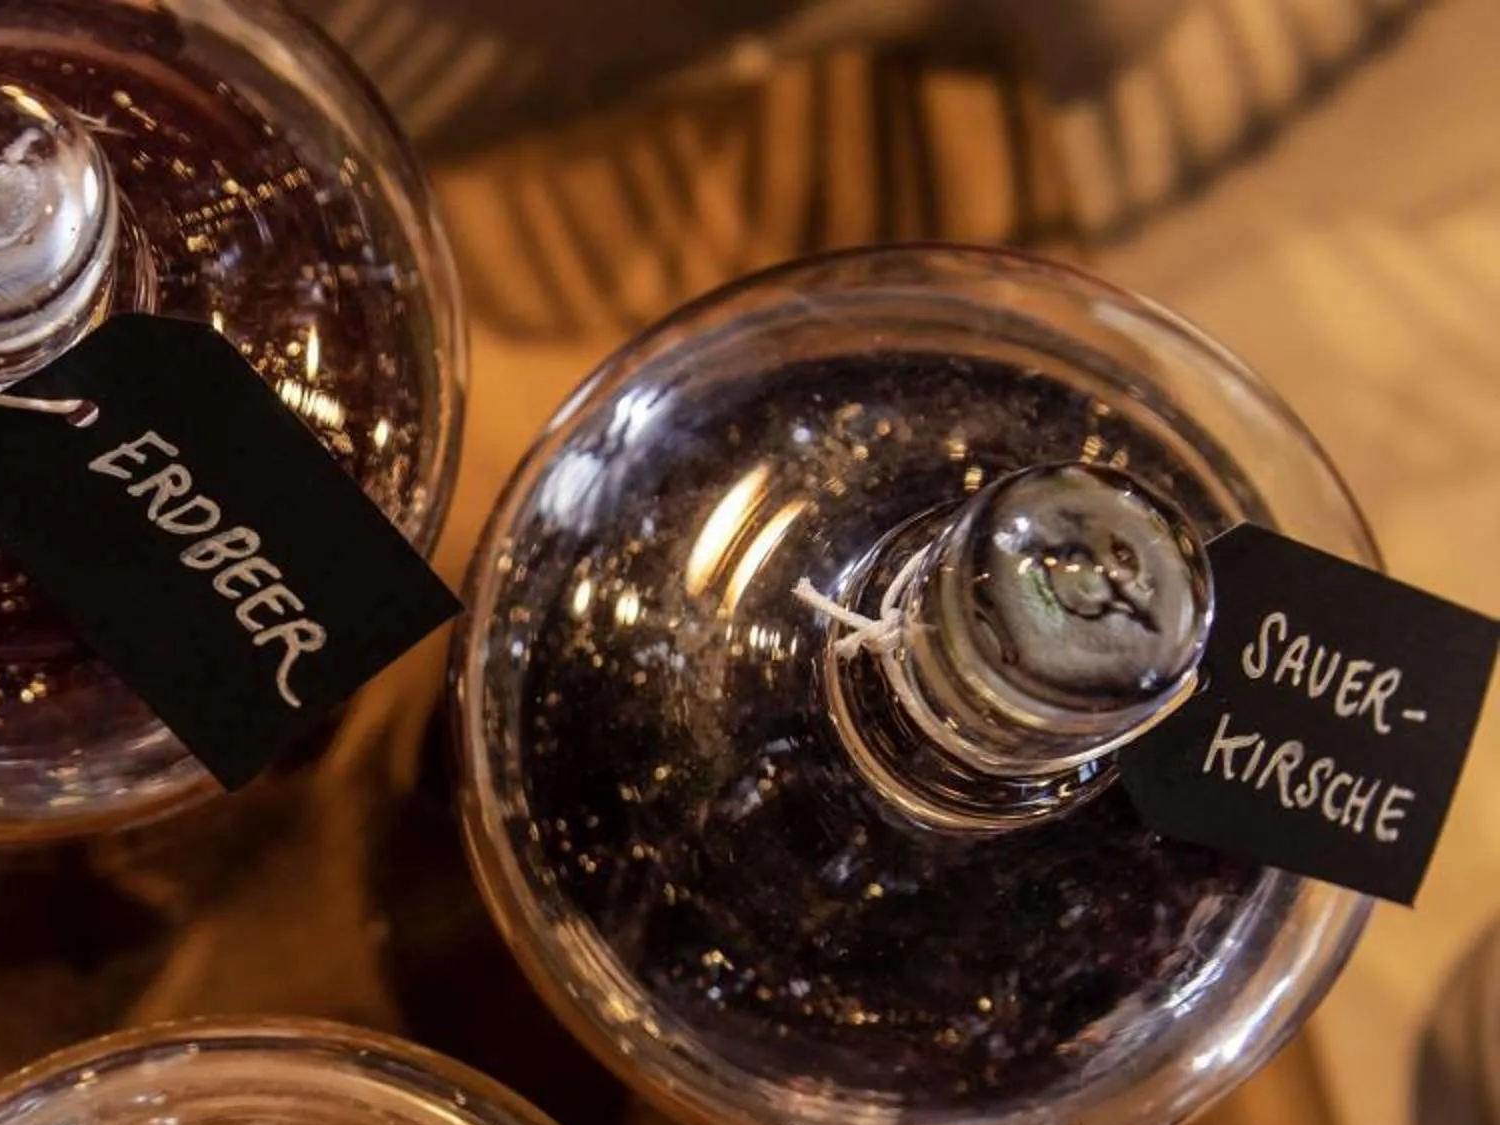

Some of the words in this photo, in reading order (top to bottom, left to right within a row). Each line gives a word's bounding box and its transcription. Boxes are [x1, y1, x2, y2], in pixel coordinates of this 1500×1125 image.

[88, 430, 328, 708] ERDBEER
[1242, 611, 1428, 735] SAUER-
[1202, 712, 1416, 842] KIRSCHE
